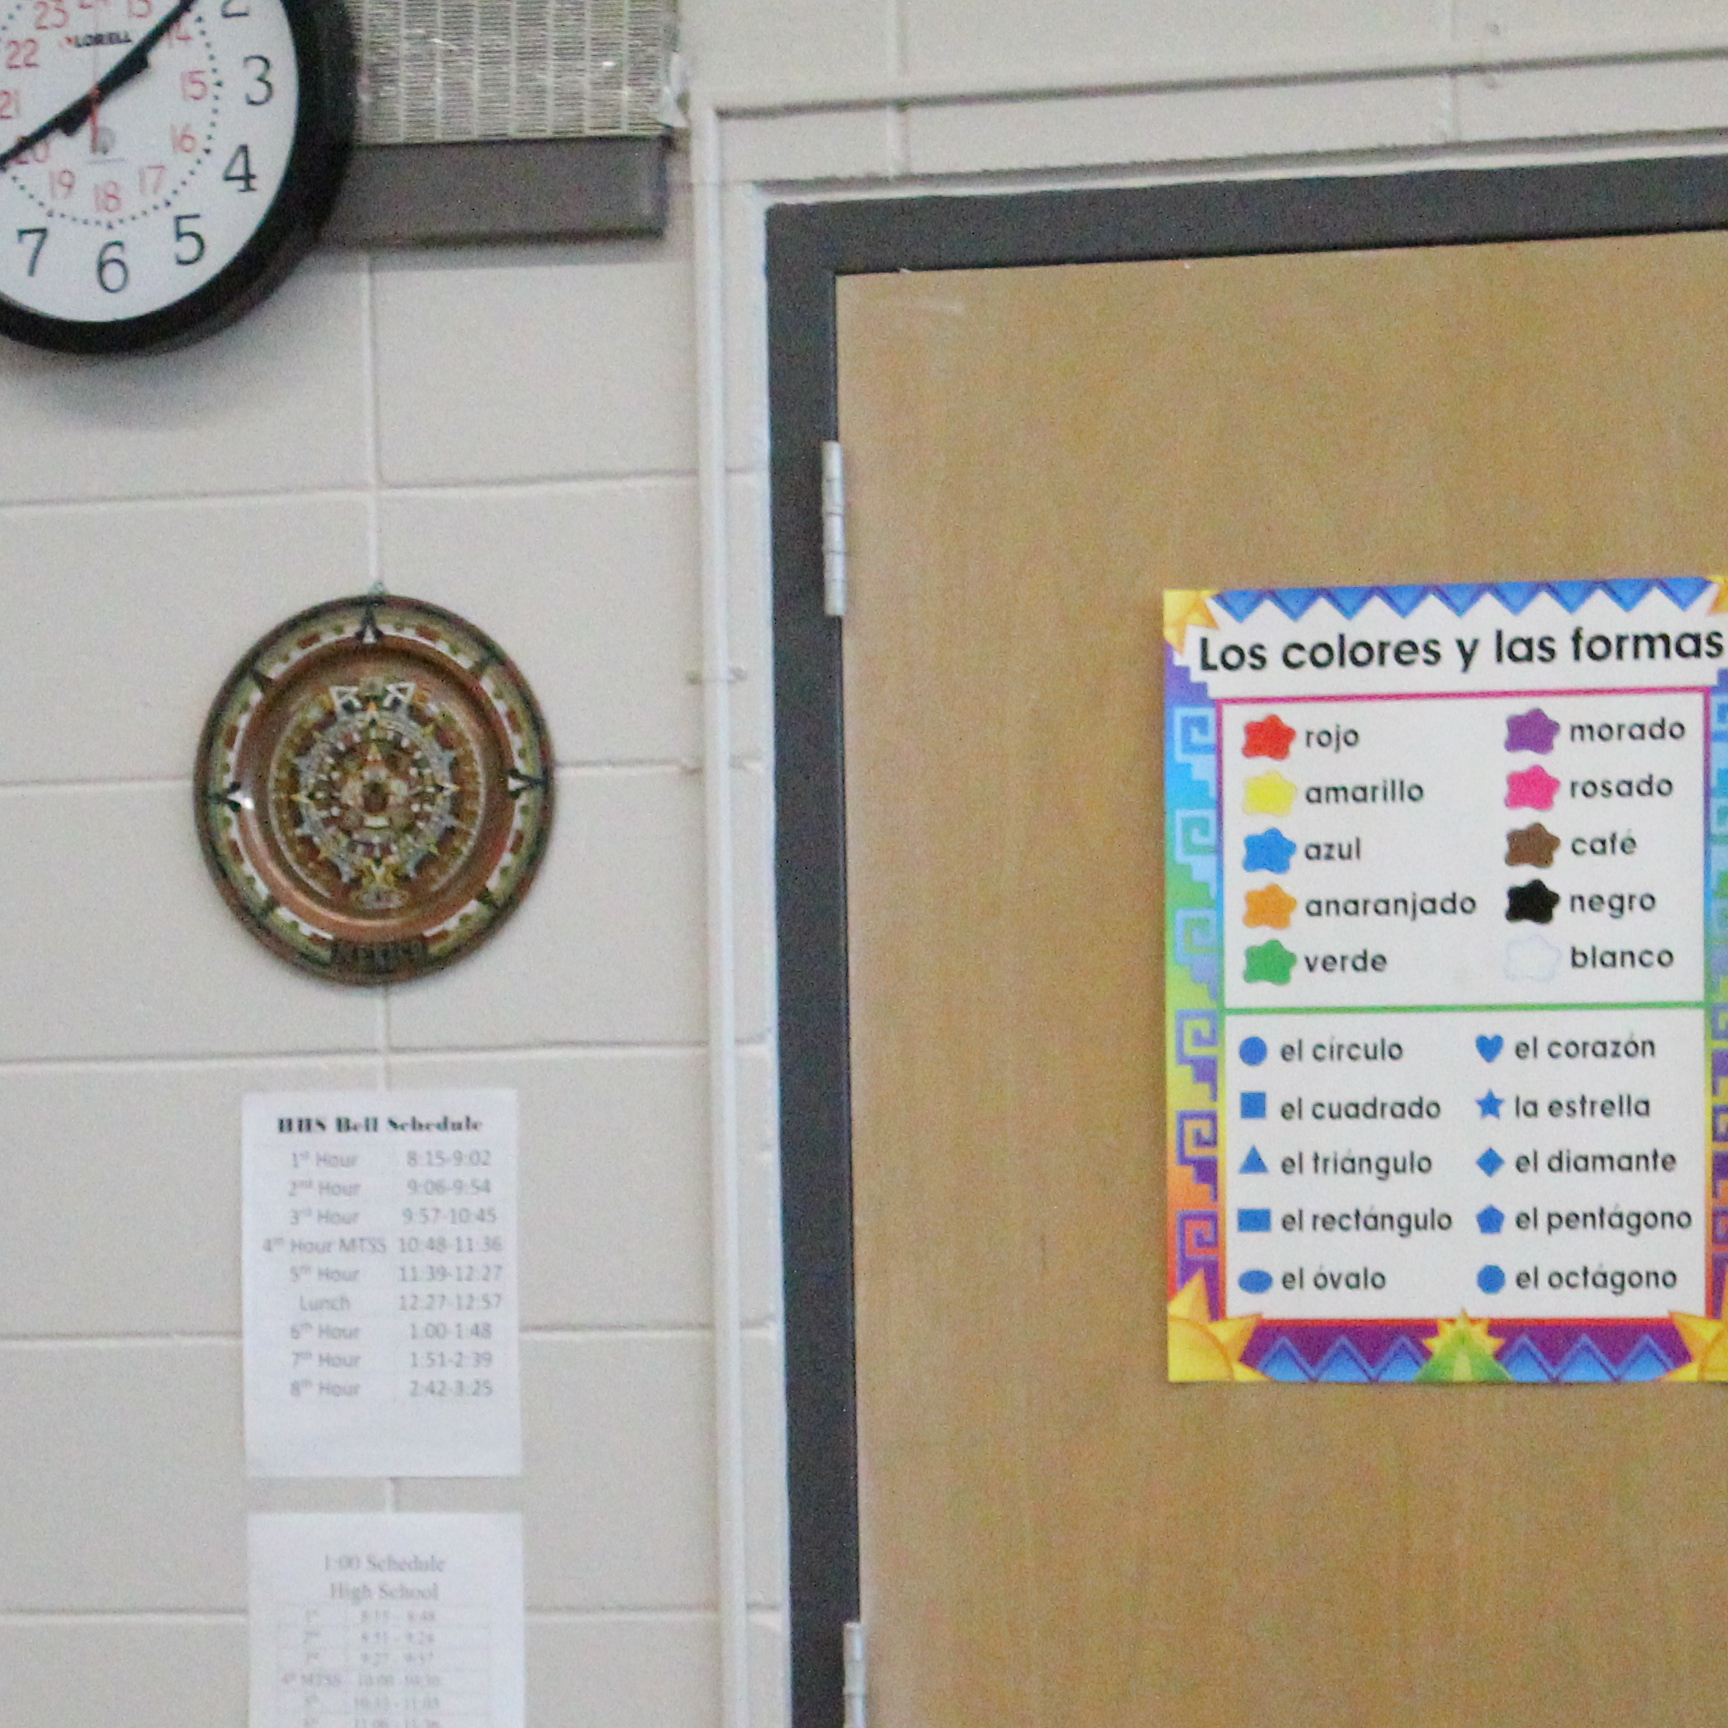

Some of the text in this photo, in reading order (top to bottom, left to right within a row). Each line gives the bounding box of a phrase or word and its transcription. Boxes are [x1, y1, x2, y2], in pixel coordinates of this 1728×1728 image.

[35, 1, 70, 30] 23
[6, 39, 39, 69] 22
[181, 70, 208, 101] 15
[243, 55, 274, 106] 3
[172, 124, 197, 153] 16
[139, 165, 168, 195] 17
[223, 144, 257, 192] 4
[49, 170, 75, 199] 19
[95, 180, 122, 212] 18
[17, 228, 48, 277] 7
[174, 215, 205, 265] 5
[97, 241, 128, 293] 6
[1201, 626, 1724, 672] Los colores y las formas
[1305, 723, 1360, 754] rojo
[1570, 716, 1686, 743] morado
[1305, 779, 1425, 805] amarillo
[1570, 773, 1673, 799] rosado
[1305, 837, 1362, 863] azul
[1571, 830, 1637, 857] café
[1305, 893, 1476, 921] anaranjado
[1570, 888, 1656, 917] negro
[1305, 950, 1387, 973] verde
[1570, 944, 1674, 969] blanco
[1280, 1035, 1403, 1062] el círculo
[1514, 1032, 1655, 1059] el corazón
[1280, 1096, 1441, 1120] el cuadrado
[1515, 1094, 1650, 1118] la estrella
[335, 1116, 379, 1134] Bell
[388, 1115, 483, 1133] Schedule
[315, 1152, 359, 1168] Hour
[1280, 1150, 1433, 1181] el triángulo
[1515, 1148, 1676, 1173] el diamante
[318, 1181, 361, 1197] Hour
[317, 1209, 360, 1225] Hour
[1281, 1208, 1452, 1238] el rectángulo
[1515, 1203, 1692, 1237] el pentágono
[290, 1239, 333, 1254] Hour
[318, 1267, 360, 1282] Hour
[1281, 1264, 1385, 1290] el óvalo
[1515, 1263, 1676, 1296] el octágono
[298, 1295, 351, 1311] Lunch
[318, 1324, 360, 1339] Hour
[318, 1353, 361, 1368] Hour
[318, 1381, 361, 1396] Hour
[366, 1554, 446, 1572] Schedule
[329, 1582, 439, 1604] High School
